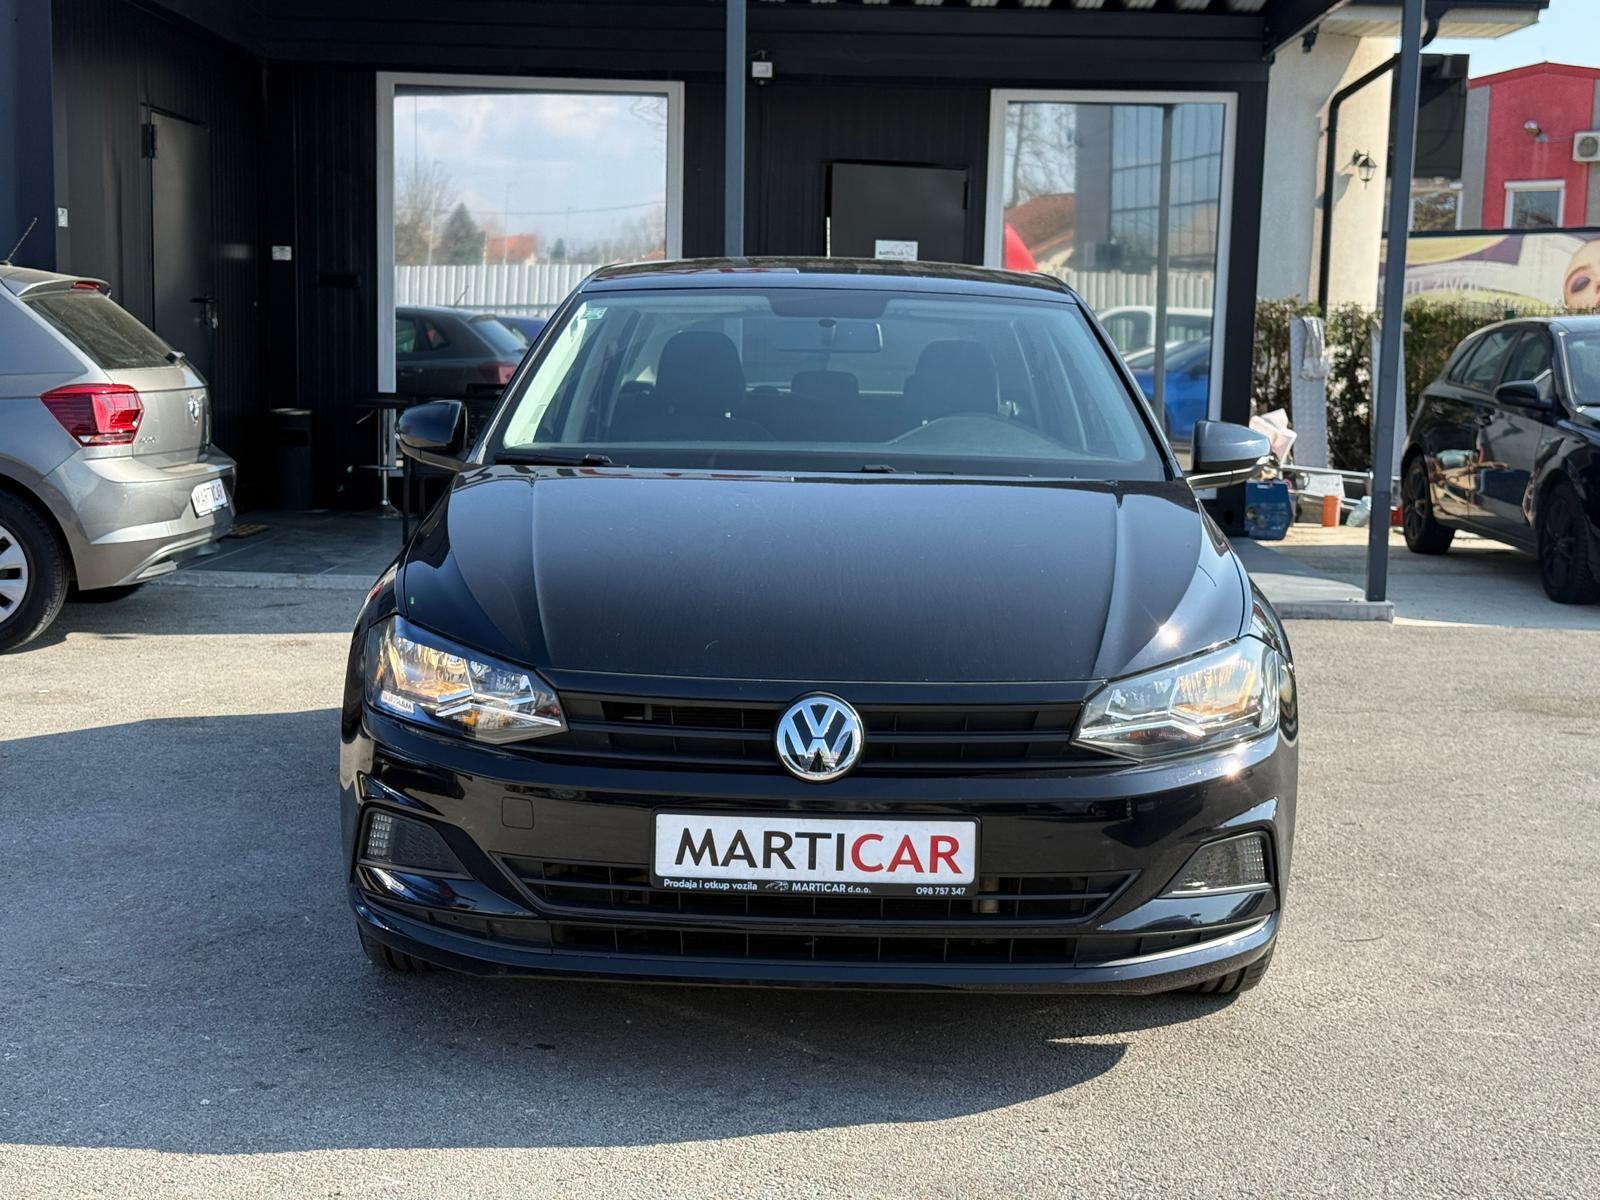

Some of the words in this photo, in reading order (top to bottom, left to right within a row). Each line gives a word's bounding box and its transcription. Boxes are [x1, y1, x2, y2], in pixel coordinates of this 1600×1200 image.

[674, 827, 963, 875] MARTICAR
[663, 878, 698, 889] Prodaja
[703, 881, 730, 891] otkup
[731, 881, 758, 891] vozila
[791, 882, 846, 893] MARTICAR
[847, 886, 872, 894] d.o.o.
[915, 886, 933, 895] 098
[934, 887, 949, 895] 757
[951, 887, 966, 896] 347
